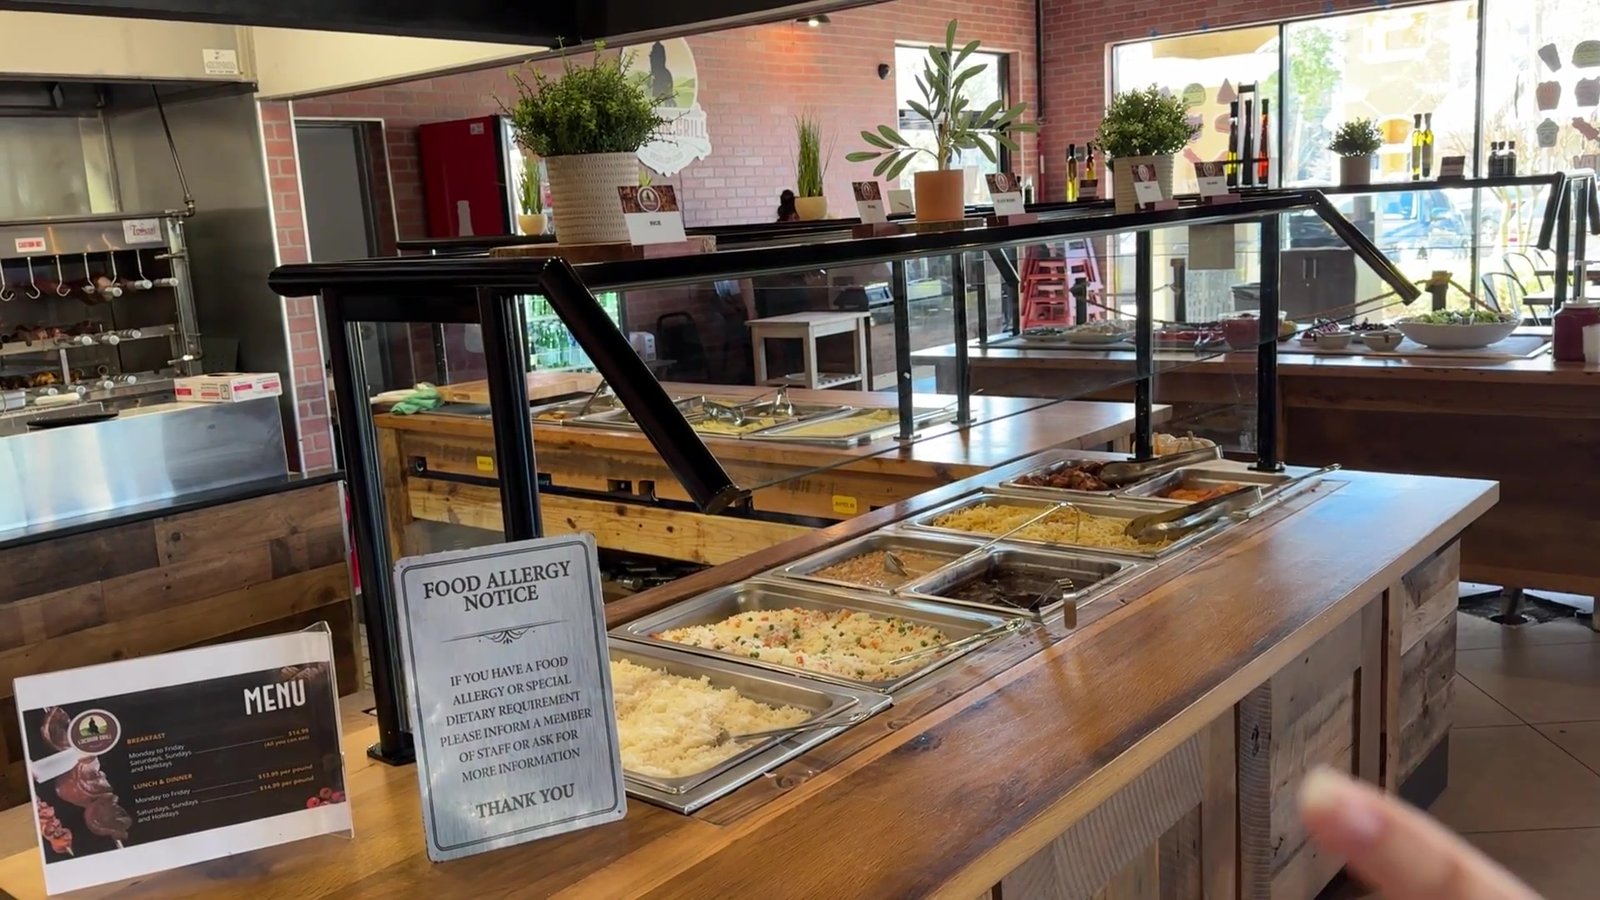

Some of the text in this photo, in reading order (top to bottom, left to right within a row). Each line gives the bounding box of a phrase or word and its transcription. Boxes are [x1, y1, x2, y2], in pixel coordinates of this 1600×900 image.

[423, 560, 571, 599] FOOD ALLERGY
[463, 584, 539, 612] NOTICE
[450, 656, 568, 687] IF YOU HAVE A FOOD
[243, 679, 306, 715] MENU
[453, 674, 572, 706] ALLERGY OR SPECIAL
[446, 690, 581, 726] DIETARY REQUIREMENT
[126, 732, 166, 745] BREAKFAST
[440, 708, 592, 748] PLEASE INFORM A MEMBER
[128, 750, 155, 760] Monday
[164, 744, 185, 752] Friday
[129, 750, 192, 766] Saturdays, Sundays
[459, 729, 579, 763] OF STAFF OR ASK FOR
[131, 761, 172, 774] and Holidays
[462, 748, 581, 783] MORE INFORMATION
[133, 781, 158, 791] LUNCH
[166, 773, 193, 783] DINNER
[135, 794, 161, 804] Monday
[170, 788, 191, 797] Friday
[136, 799, 199, 816] Saturdays, Sundays
[476, 783, 575, 819] THANK YOU
[138, 810, 179, 824] and Holidays
